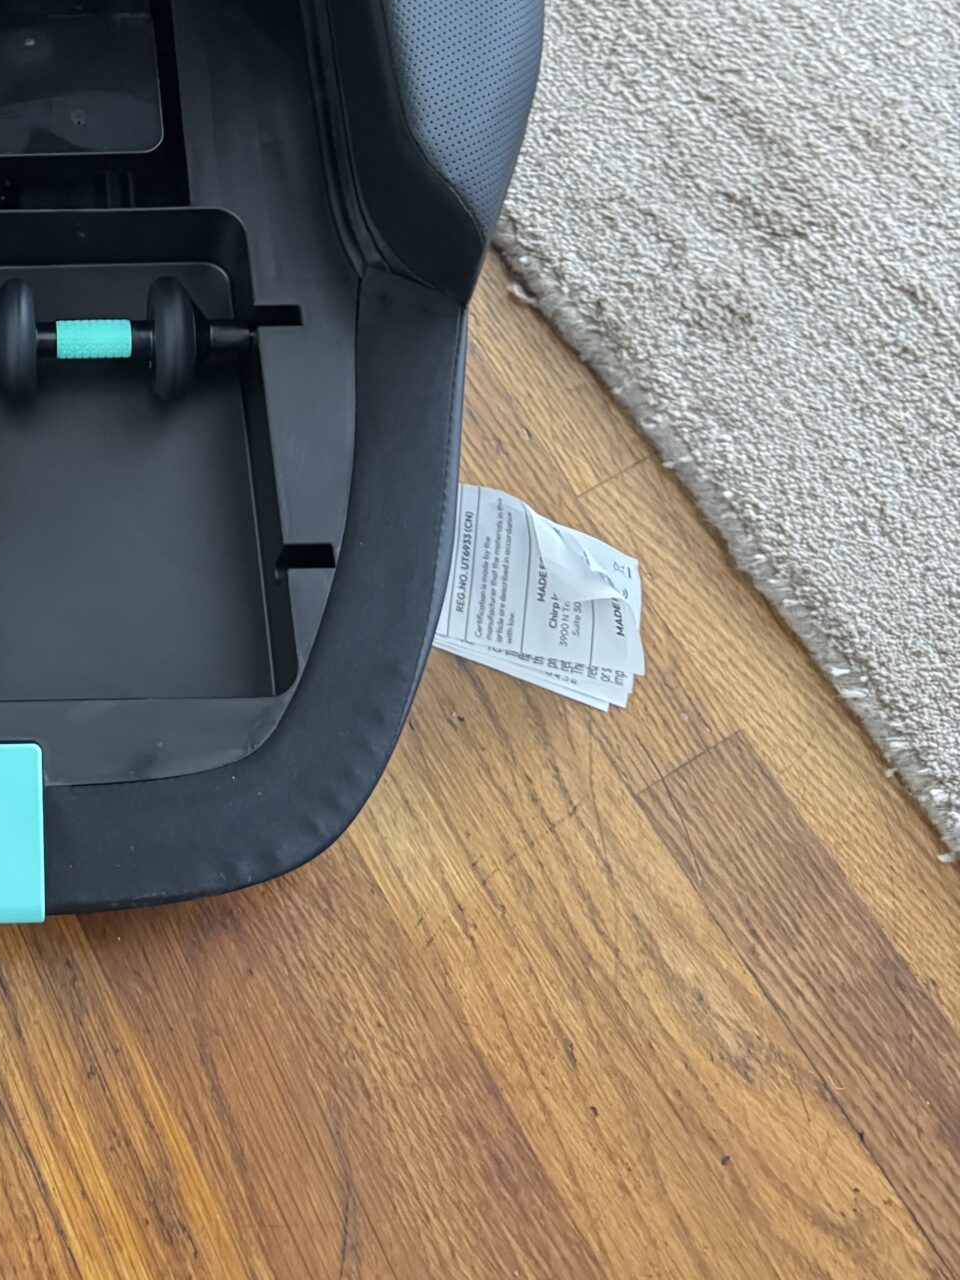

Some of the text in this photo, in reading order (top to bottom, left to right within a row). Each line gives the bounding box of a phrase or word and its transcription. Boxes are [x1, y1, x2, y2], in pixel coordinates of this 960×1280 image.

[464, 511, 474, 533] (CN)
[504, 511, 513, 555] accordance
[461, 533, 472, 570] UT6933
[475, 591, 487, 638] Certification
[483, 549, 491, 560] by
[486, 587, 498, 641] manufacturer
[494, 520, 503, 556] materials
[500, 564, 510, 602] described
[537, 571, 547, 602] MADE
[497, 617, 505, 643] article
[549, 602, 561, 629] Chirp
[562, 614, 570, 622] N
[572, 615, 582, 637] Suite
[612, 605, 625, 637] MADE
[560, 623, 570, 647] 3900
